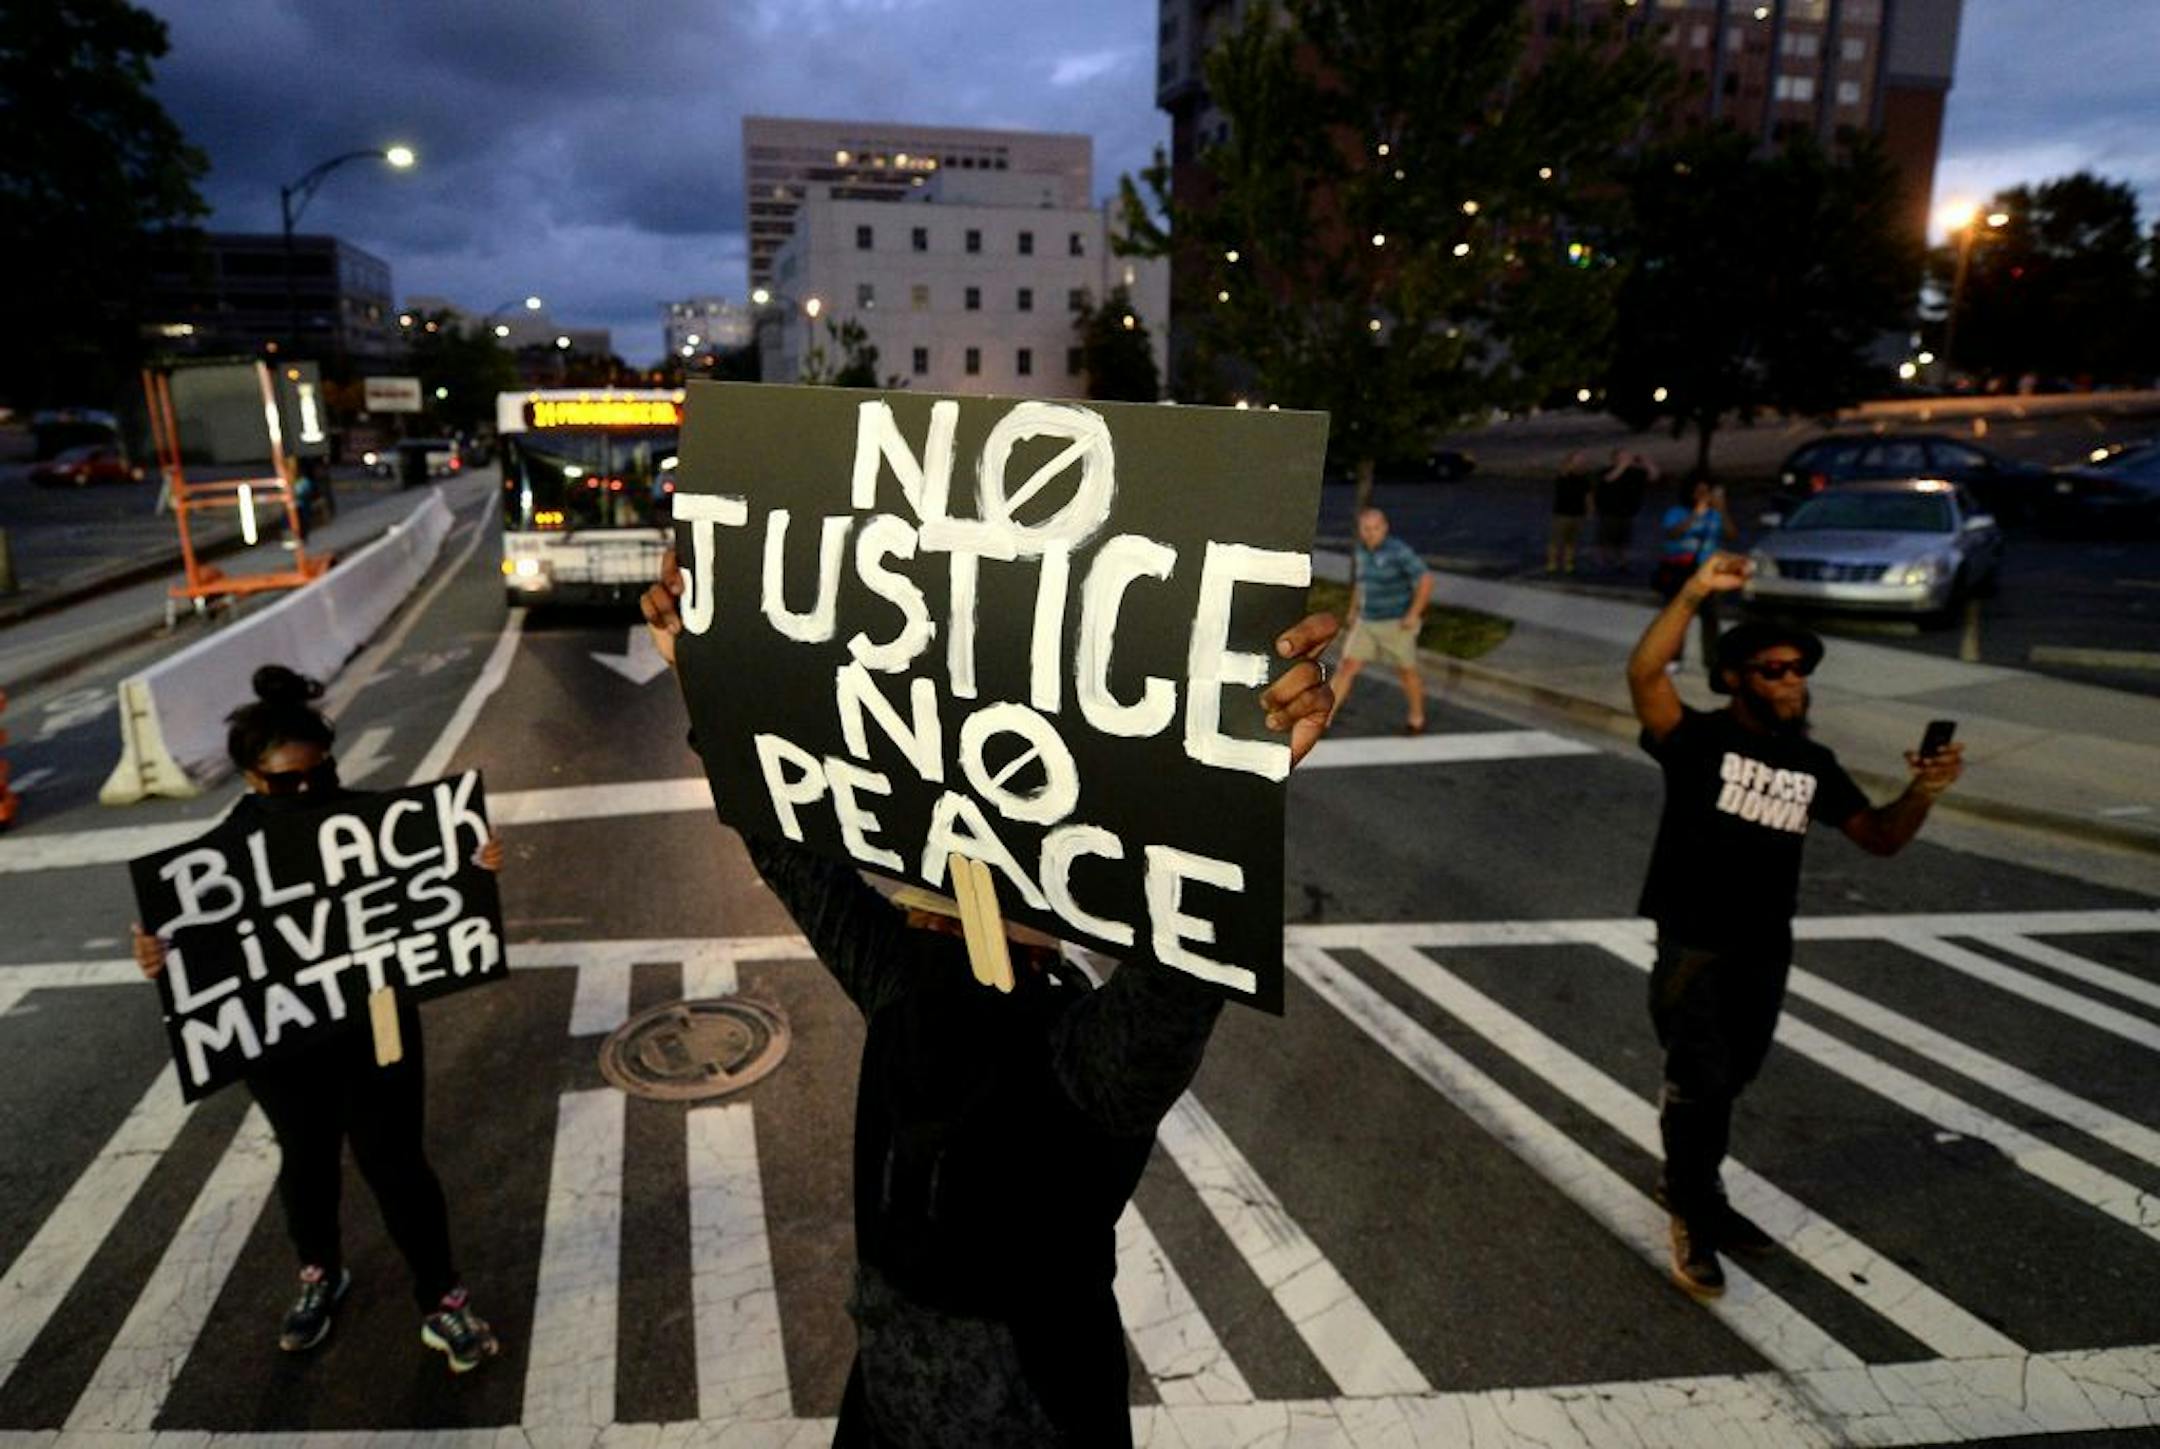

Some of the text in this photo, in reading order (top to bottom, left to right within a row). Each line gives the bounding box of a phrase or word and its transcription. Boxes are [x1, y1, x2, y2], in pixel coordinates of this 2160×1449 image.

[672, 493, 1312, 782] JUSTICE
[156, 769, 491, 938] BLACK
[754, 733, 1257, 993] PEACE
[181, 916, 500, 1087] MATTER
